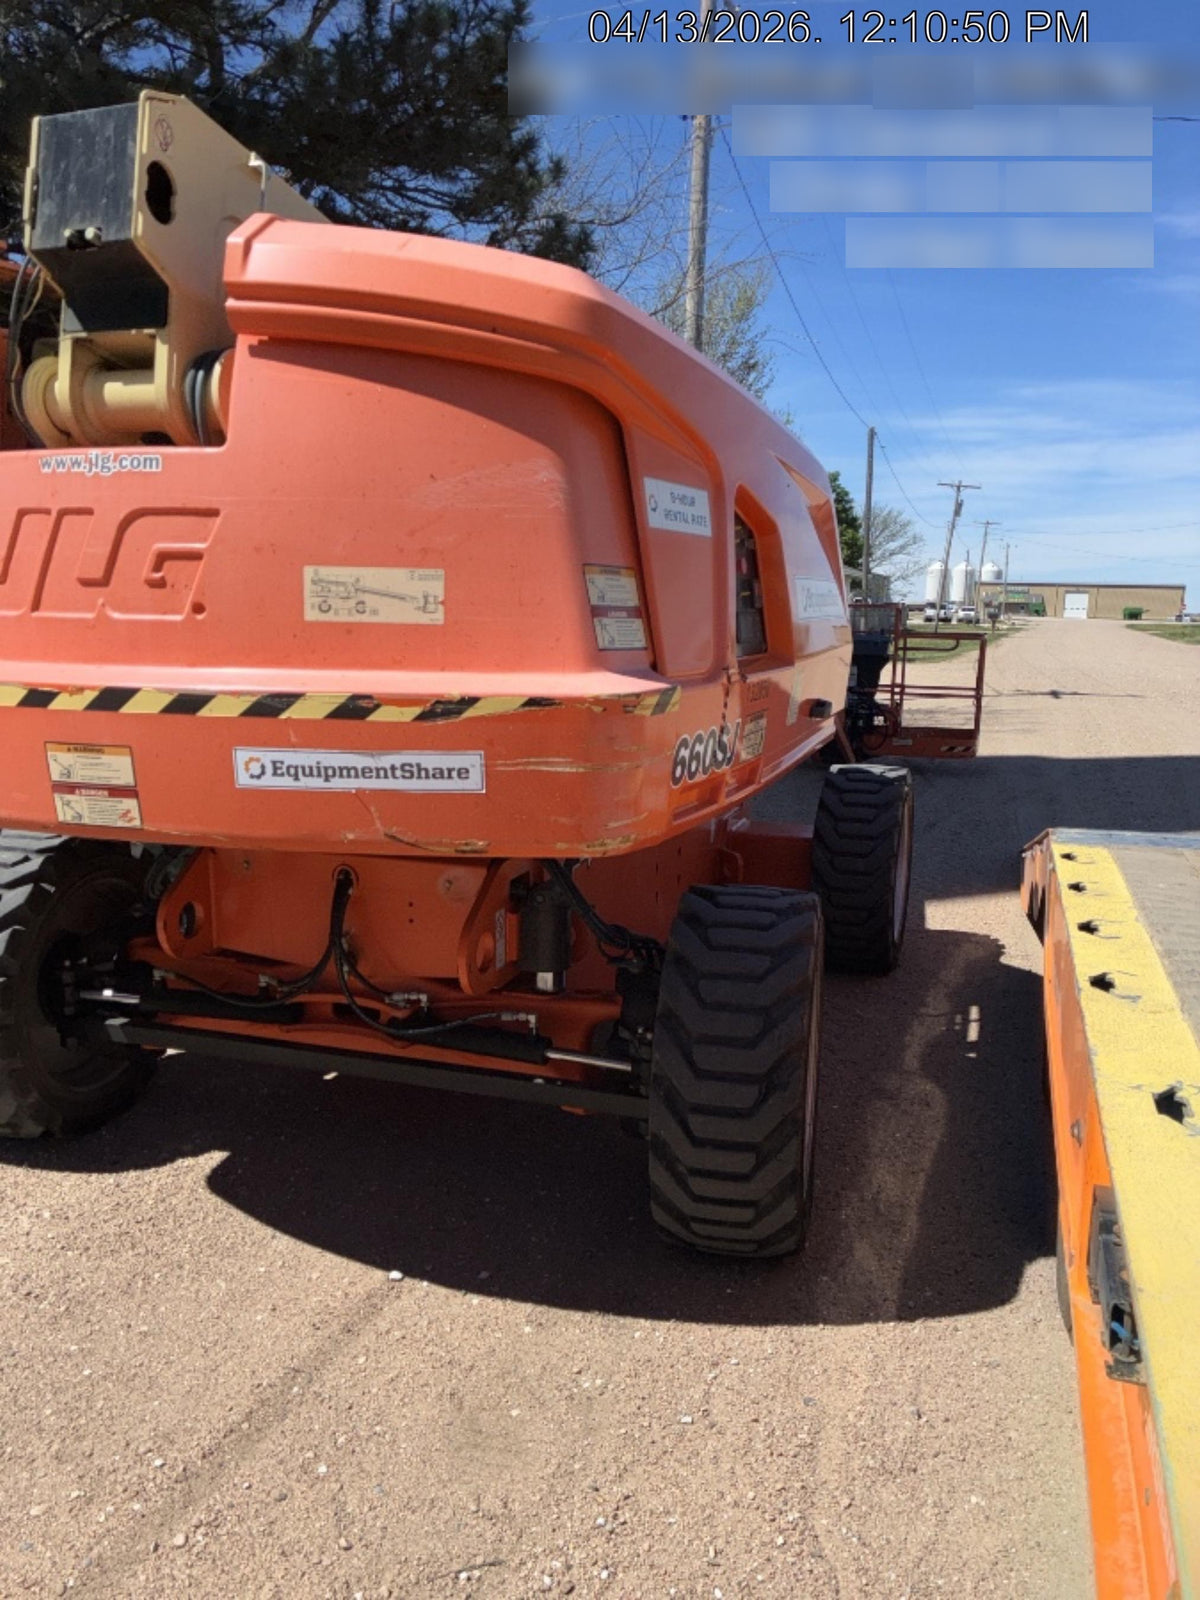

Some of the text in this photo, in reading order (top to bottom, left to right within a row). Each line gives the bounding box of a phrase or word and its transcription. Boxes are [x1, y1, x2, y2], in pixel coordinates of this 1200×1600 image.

[40, 452, 162, 475] www.jlg.com
[670, 718, 742, 788] 660SJ
[270, 760, 470, 781] EquipmentShare
